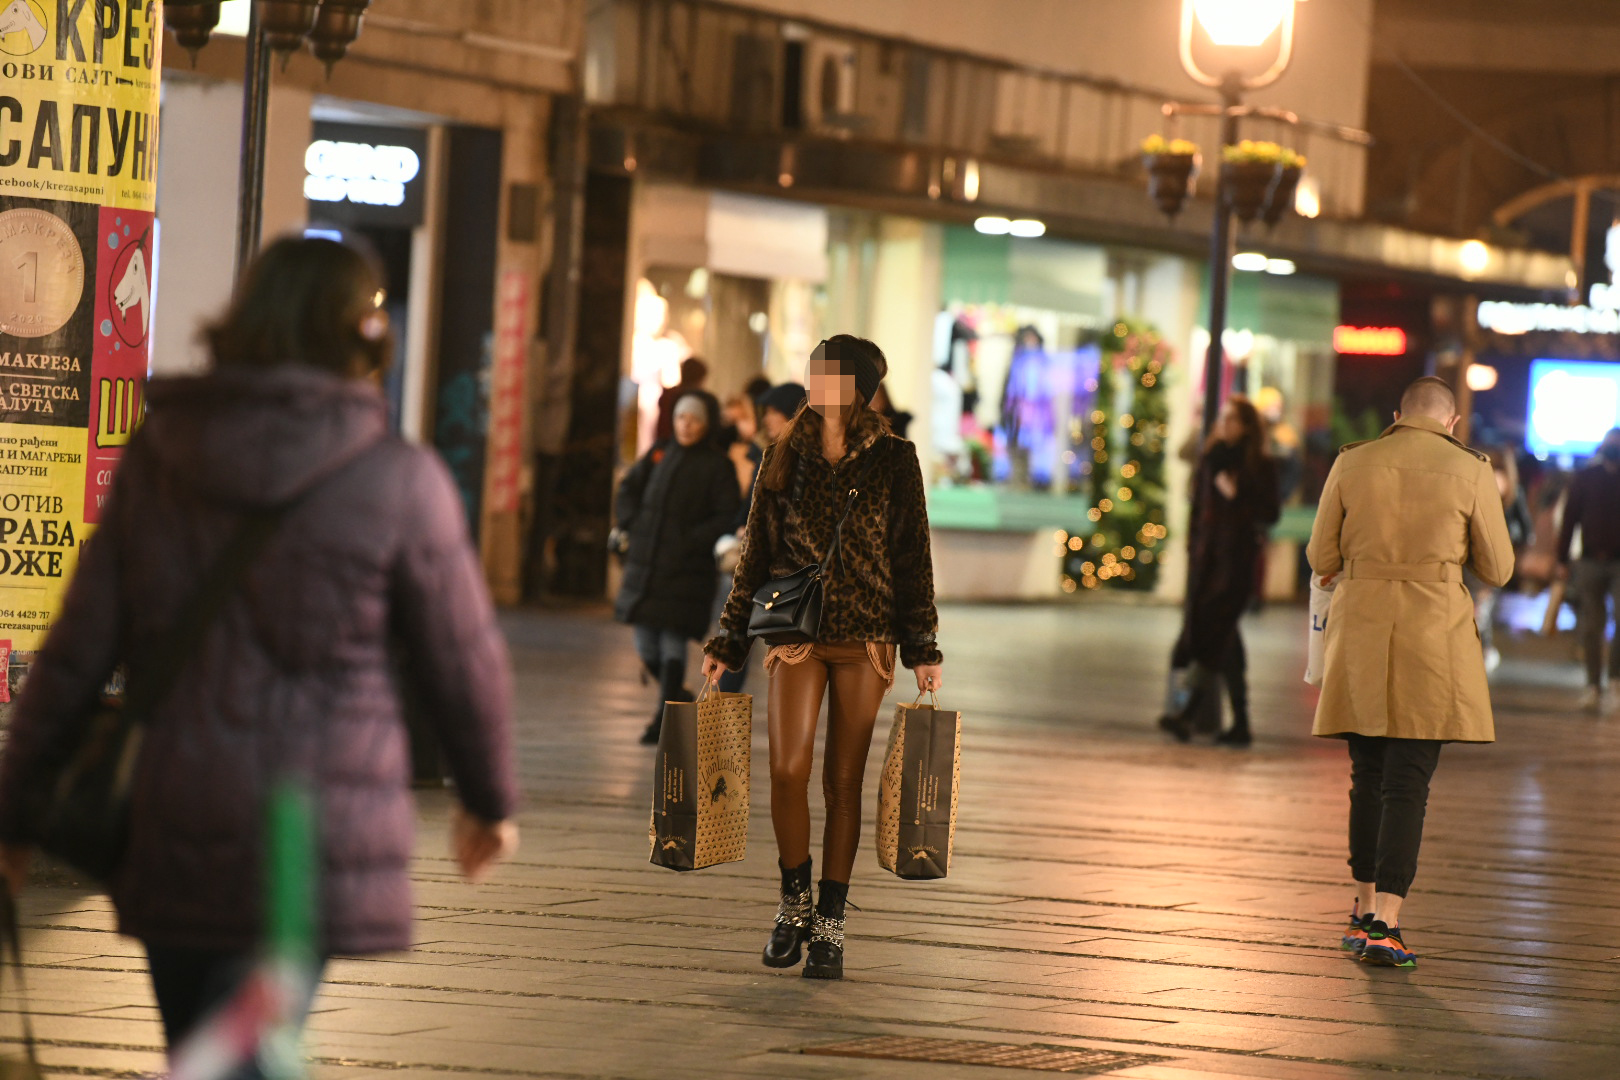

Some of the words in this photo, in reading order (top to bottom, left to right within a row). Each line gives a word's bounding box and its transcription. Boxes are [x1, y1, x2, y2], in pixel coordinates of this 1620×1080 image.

[65, 66, 113, 87] САЈТ
[11, 250, 38, 303] 1
[10, 311, 43, 325] 2020
[0, 351, 81, 372] МАКРЕЗА
[9, 382, 80, 401] СВЕТСКА
[19, 435, 59, 449] рађени
[20, 450, 81, 464] МАГАРЕЋИ
[0, 464, 48, 477] АПУНИ
[0, 493, 63, 514] ОТИВ
[0, 517, 75, 547] РАБА
[17, 610, 37, 619] 4429
[39, 611, 50, 619] 717
